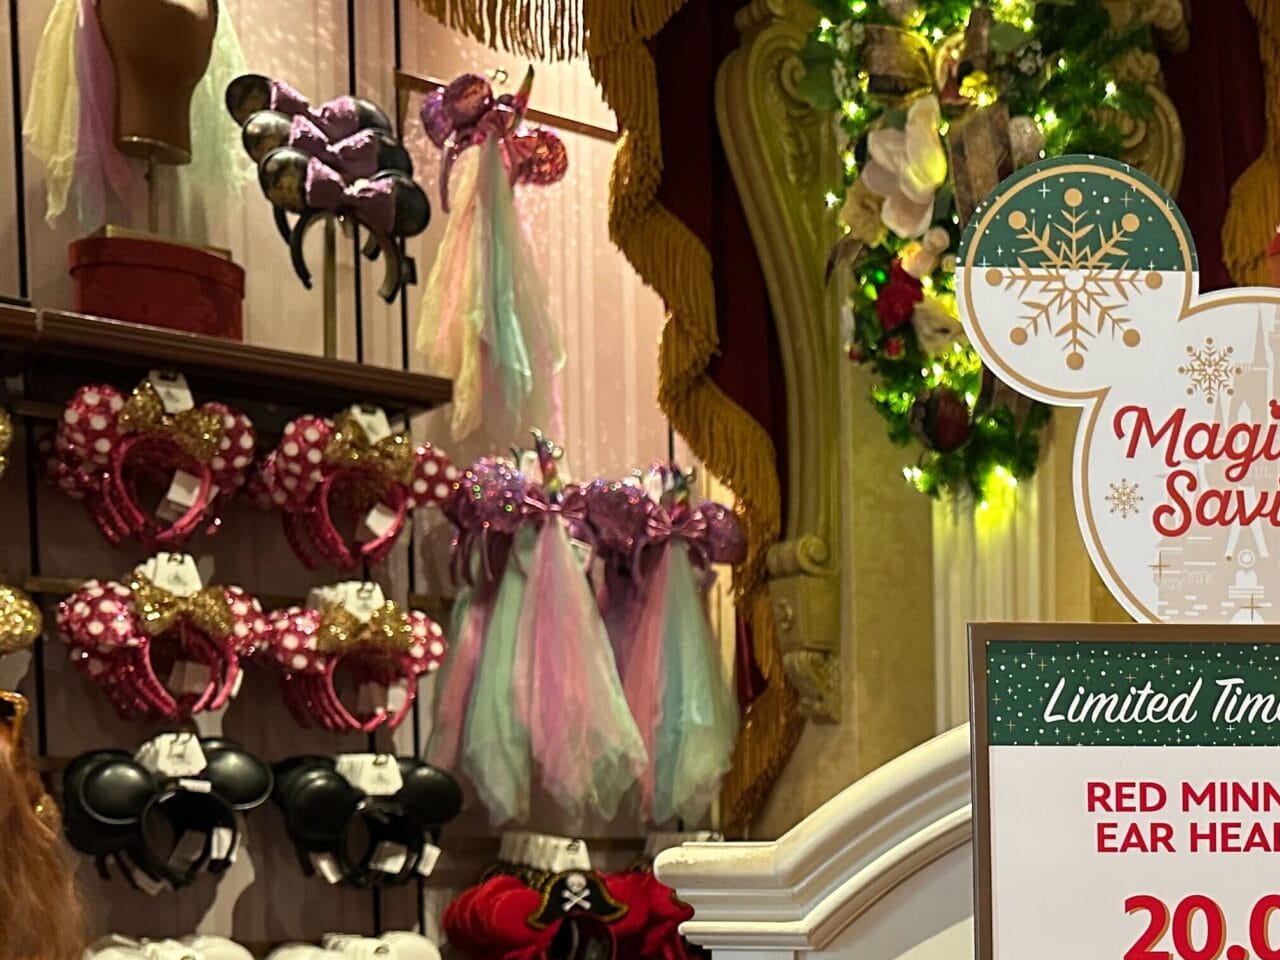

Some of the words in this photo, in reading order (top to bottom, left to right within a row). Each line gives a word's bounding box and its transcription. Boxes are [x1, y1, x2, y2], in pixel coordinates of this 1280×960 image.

[1043, 677, 1202, 723] Limited
[1087, 782, 1167, 813] RED
[1096, 822, 1176, 853] EAR
